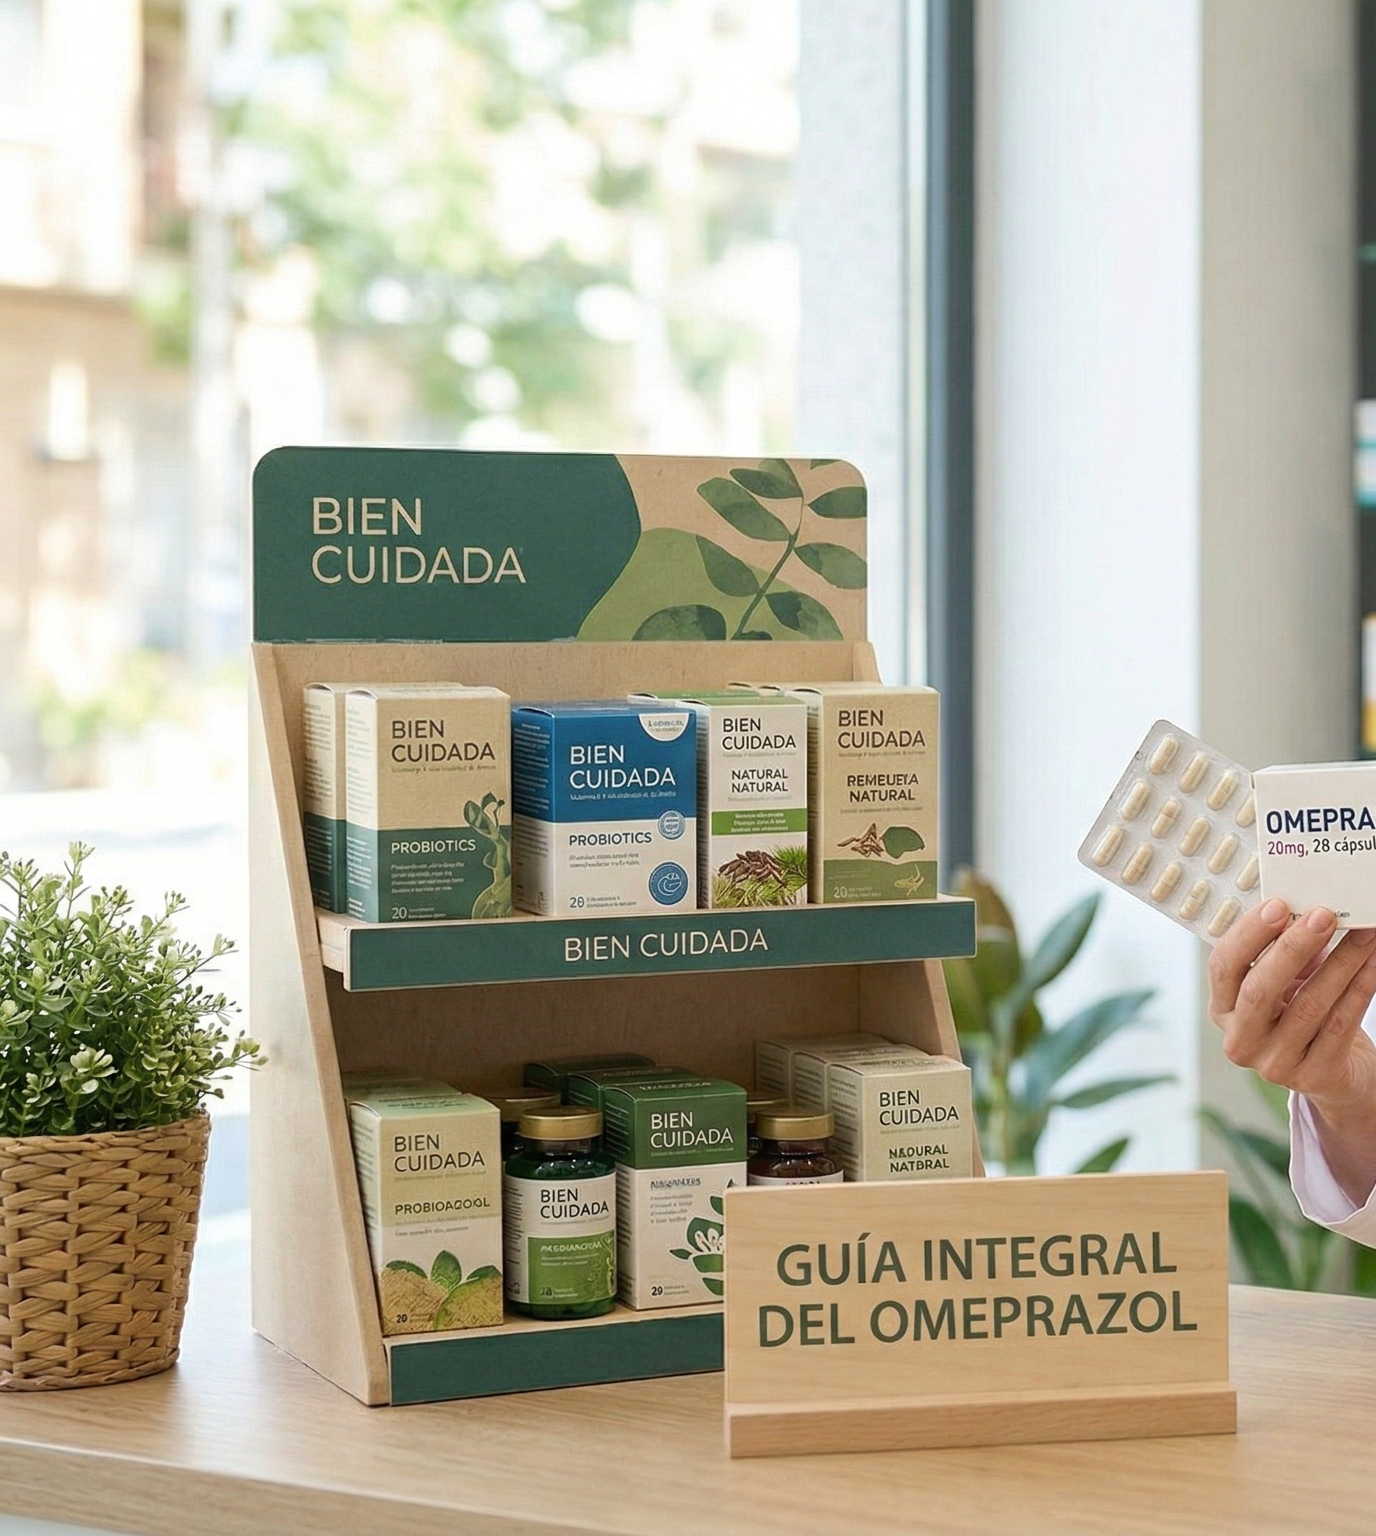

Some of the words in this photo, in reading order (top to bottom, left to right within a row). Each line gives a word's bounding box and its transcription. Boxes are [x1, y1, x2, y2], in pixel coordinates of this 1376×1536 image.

[312, 496, 423, 536] BIEN
[311, 544, 527, 584] CUIDADA
[722, 717, 762, 733] BIEN
[838, 709, 884, 727] BIEN
[391, 720, 444, 739] BIEN
[722, 734, 797, 750] CUIDADA
[837, 730, 926, 749] CUIDADA
[391, 742, 496, 763] CUIDADA
[570, 744, 625, 765] BIEN
[569, 767, 676, 790] CUIDADA
[731, 768, 789, 780] NATURAL
[731, 781, 789, 793] NATURAL
[849, 789, 916, 803] NATURAL
[391, 838, 476, 854] PROBIOTICS
[569, 832, 652, 846] PROBIOTICS
[1267, 841, 1309, 857] 20mg,
[1313, 838, 1331, 853] 28
[833, 886, 848, 898] 20
[391, 906, 408, 920] 20
[564, 935, 631, 962] BIEN
[640, 928, 769, 957] CUIDADA
[879, 1089, 920, 1107] BIEN
[650, 1111, 694, 1130] BIEN
[878, 1105, 959, 1126] CUIDADA
[393, 1133, 440, 1153] BIEN
[650, 1127, 734, 1149] CUIDADA
[393, 1150, 485, 1172] CUIDADA
[540, 1187, 579, 1203] BIEN
[540, 1200, 609, 1219] CUIDADA
[776, 1232, 907, 1286] GUÍA
[923, 1231, 1178, 1281] INTEGRAL
[758, 1303, 855, 1348] DEL
[869, 1290, 1198, 1344] OMEPRAZOL
